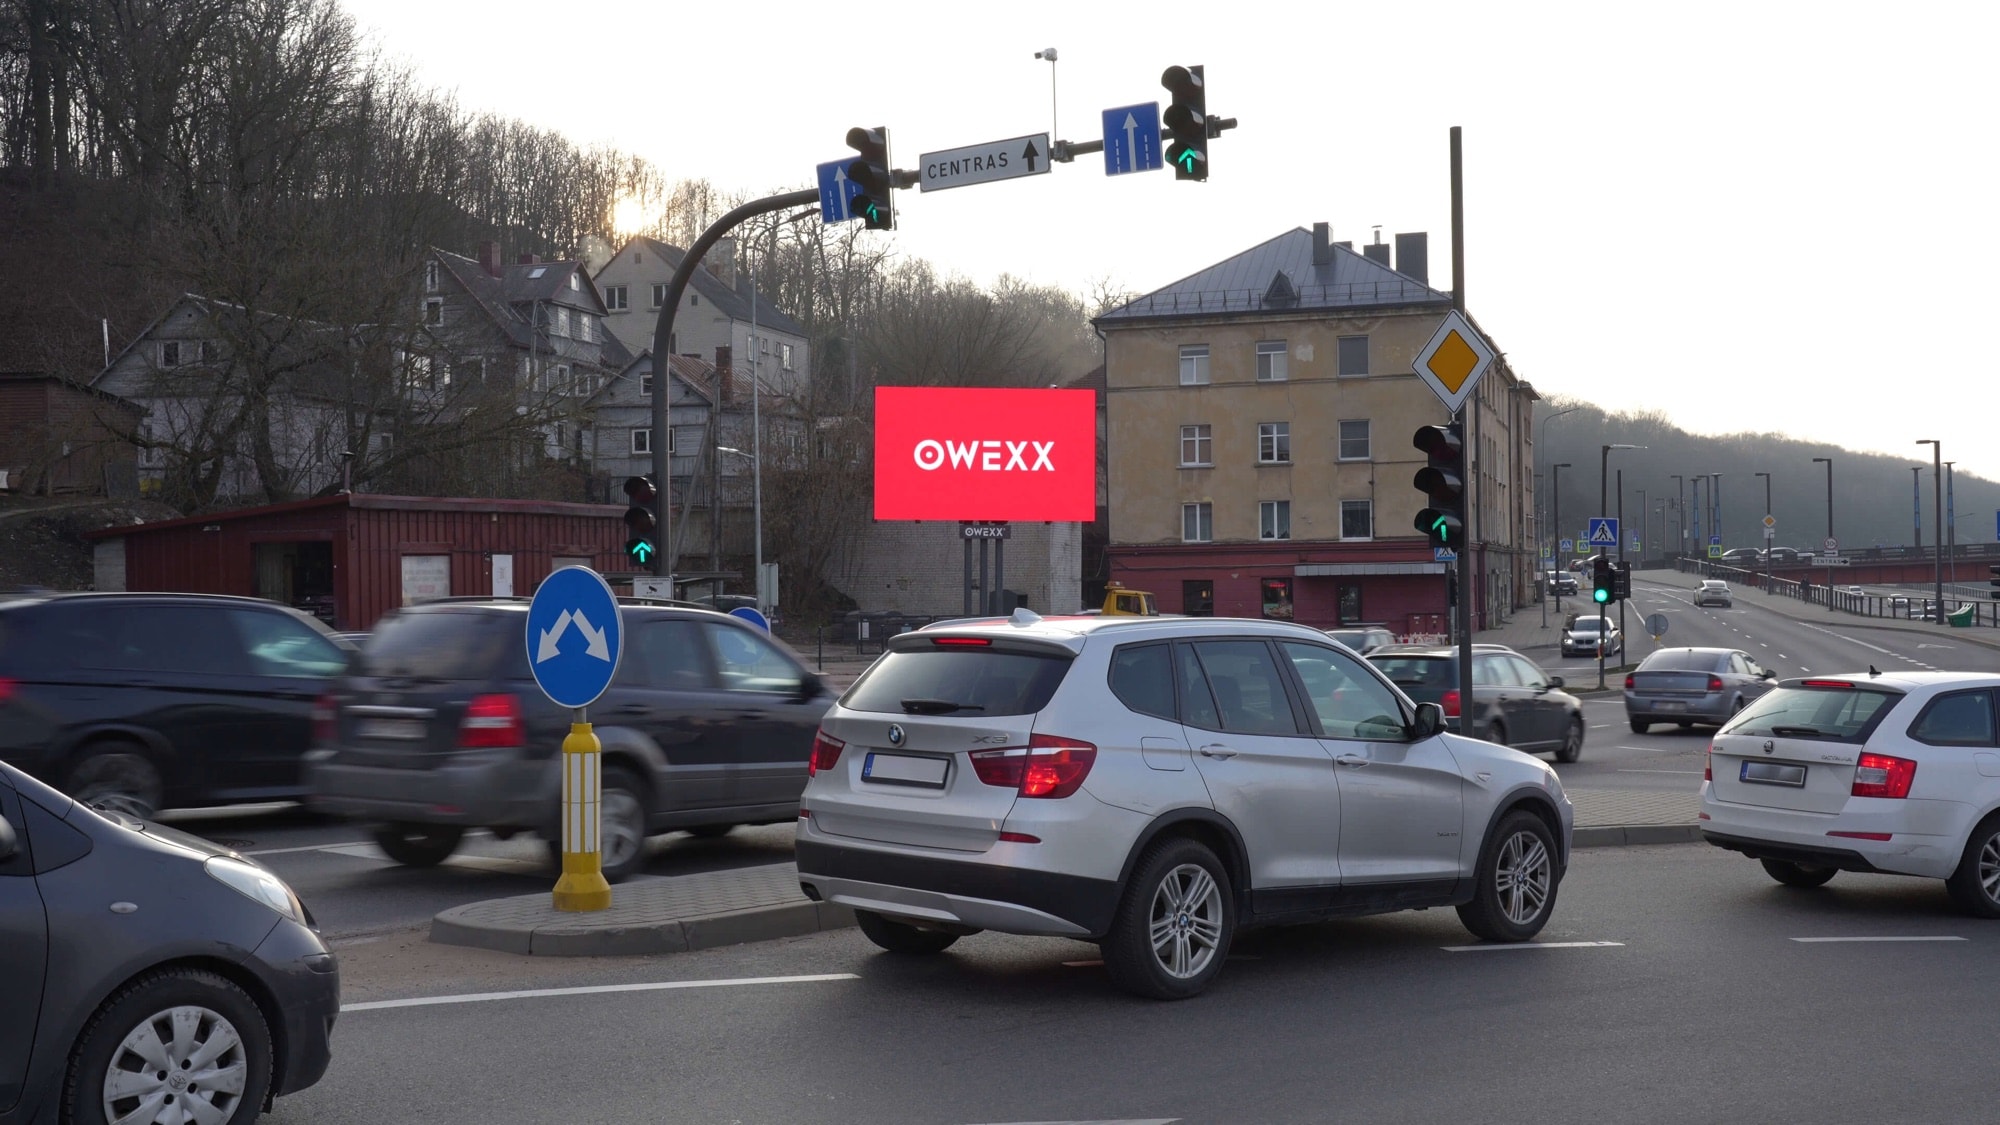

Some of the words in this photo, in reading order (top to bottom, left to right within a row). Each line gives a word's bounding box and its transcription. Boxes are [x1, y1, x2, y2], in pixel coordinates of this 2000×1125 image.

[927, 152, 1009, 179] CENTRAS
[913, 439, 1056, 471] OWEXX
[972, 734, 1009, 744] X3
